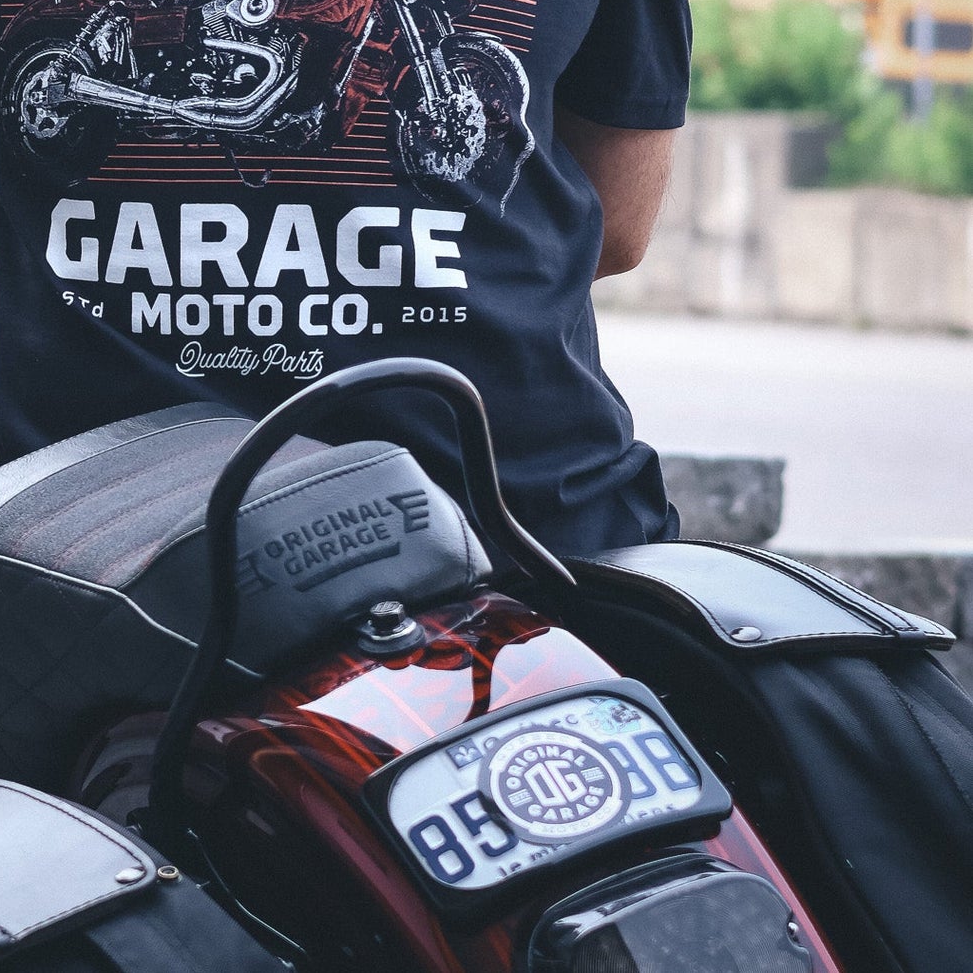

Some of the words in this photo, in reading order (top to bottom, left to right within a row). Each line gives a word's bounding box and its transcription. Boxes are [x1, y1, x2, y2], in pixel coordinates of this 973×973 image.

[46, 198, 468, 289] GARAGE
[132, 292, 283, 336] MOTO
[299, 293, 383, 336] CO.
[402, 306, 467, 323] 2015
[175, 340, 260, 377] Quality
[260, 343, 325, 380] Parts
[264, 499, 393, 559] ORIGINAL
[283, 523, 392, 576] GARAGE
[506, 745, 586, 789] ORIGINAL
[527, 785, 605, 822] GARAGE
[409, 789, 520, 884] 85
